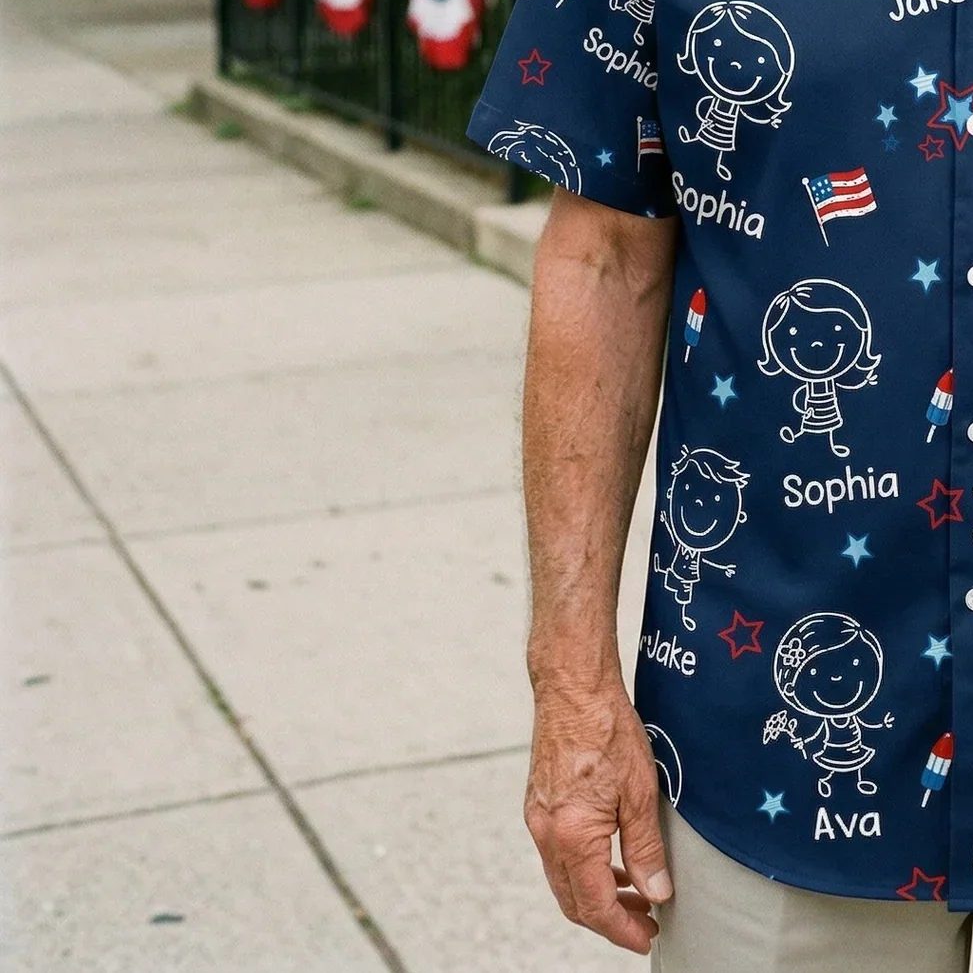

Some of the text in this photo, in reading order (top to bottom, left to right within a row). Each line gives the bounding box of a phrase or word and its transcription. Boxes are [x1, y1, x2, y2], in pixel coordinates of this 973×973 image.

[583, 27, 659, 91] Sophia
[671, 170, 766, 240] Sophia
[783, 465, 899, 514] Sophia
[813, 806, 882, 841] Ava
